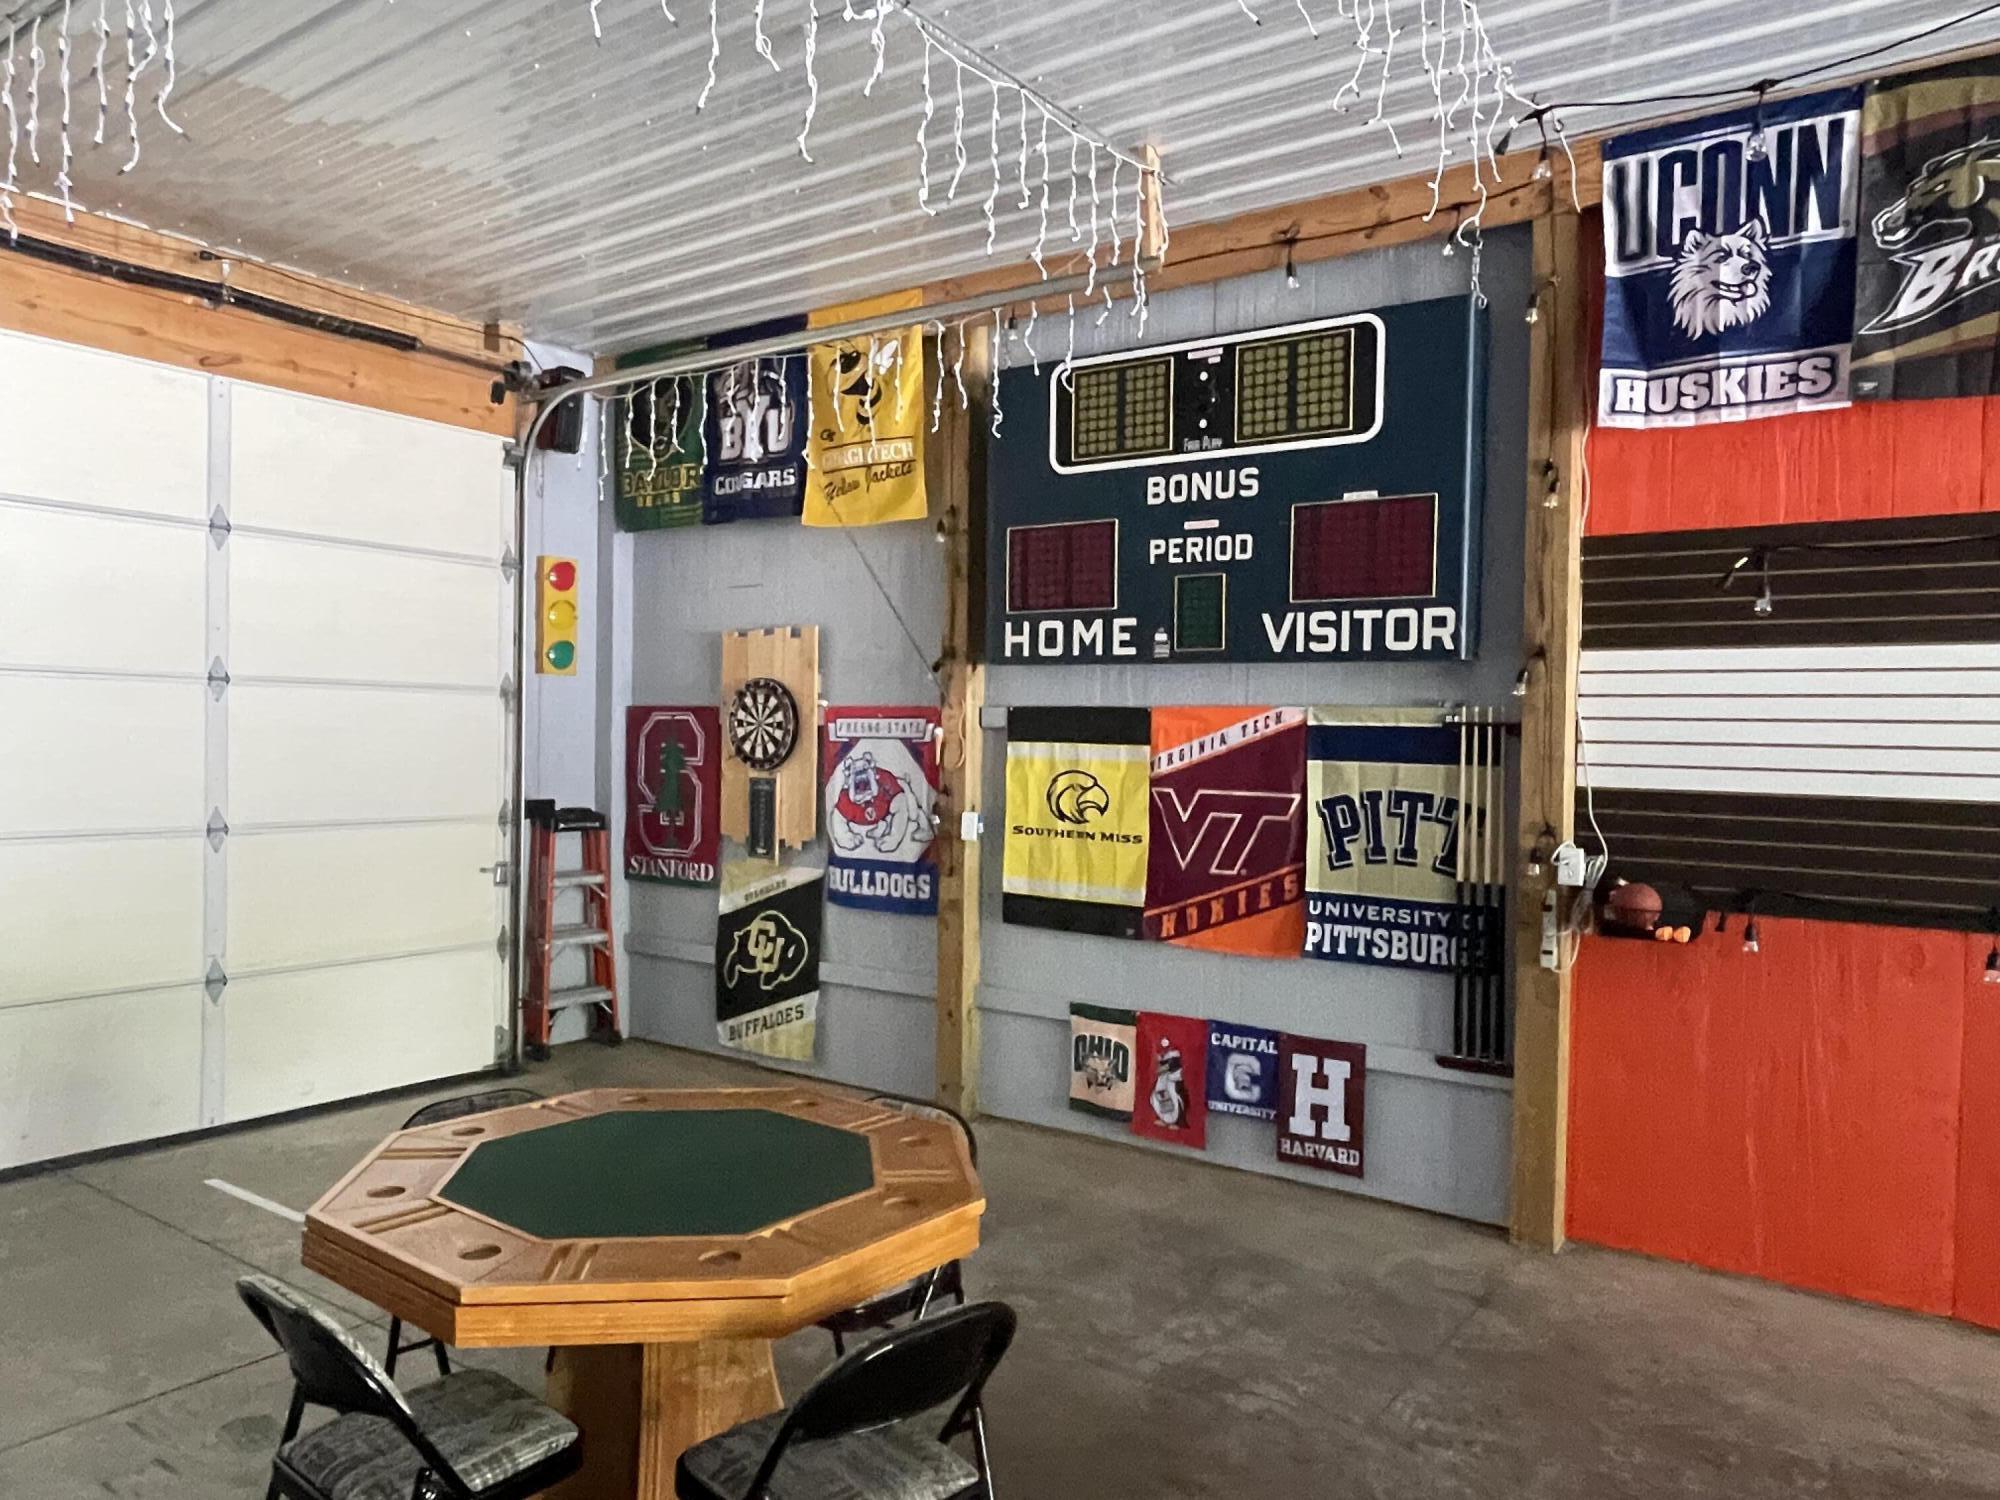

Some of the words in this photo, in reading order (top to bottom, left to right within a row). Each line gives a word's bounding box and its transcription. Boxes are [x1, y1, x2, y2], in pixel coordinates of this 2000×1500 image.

[1612, 117, 1847, 263] UCONN
[1614, 355, 1835, 413] HUSKIES
[720, 394, 792, 460] BYU
[715, 467, 795, 495] COUGARS
[1147, 467, 1260, 505] BONUS
[1149, 533, 1253, 565] PERIOD
[1004, 617, 1137, 657] HOME
[1261, 606, 1457, 654] VISITOR
[1150, 731, 1228, 773] VIRGINIA
[1241, 710, 1284, 739] TECH
[1101, 831, 1143, 844] MISS
[1151, 787, 1301, 876] VT
[629, 856, 714, 882] STANFORD
[829, 865, 931, 900] BULLDOGS
[1160, 874, 1299, 938] HOKIES
[1308, 900, 1451, 928] UNIVERSITY
[728, 1004, 805, 1041] BUFFALOES
[1074, 1034, 1130, 1083] OHIO
[1211, 1032, 1279, 1055] CAPITAL
[1208, 1101, 1277, 1121] UNIVERSITY
[1288, 1053, 1351, 1142] H
[1280, 1137, 1360, 1166] HARVARD
